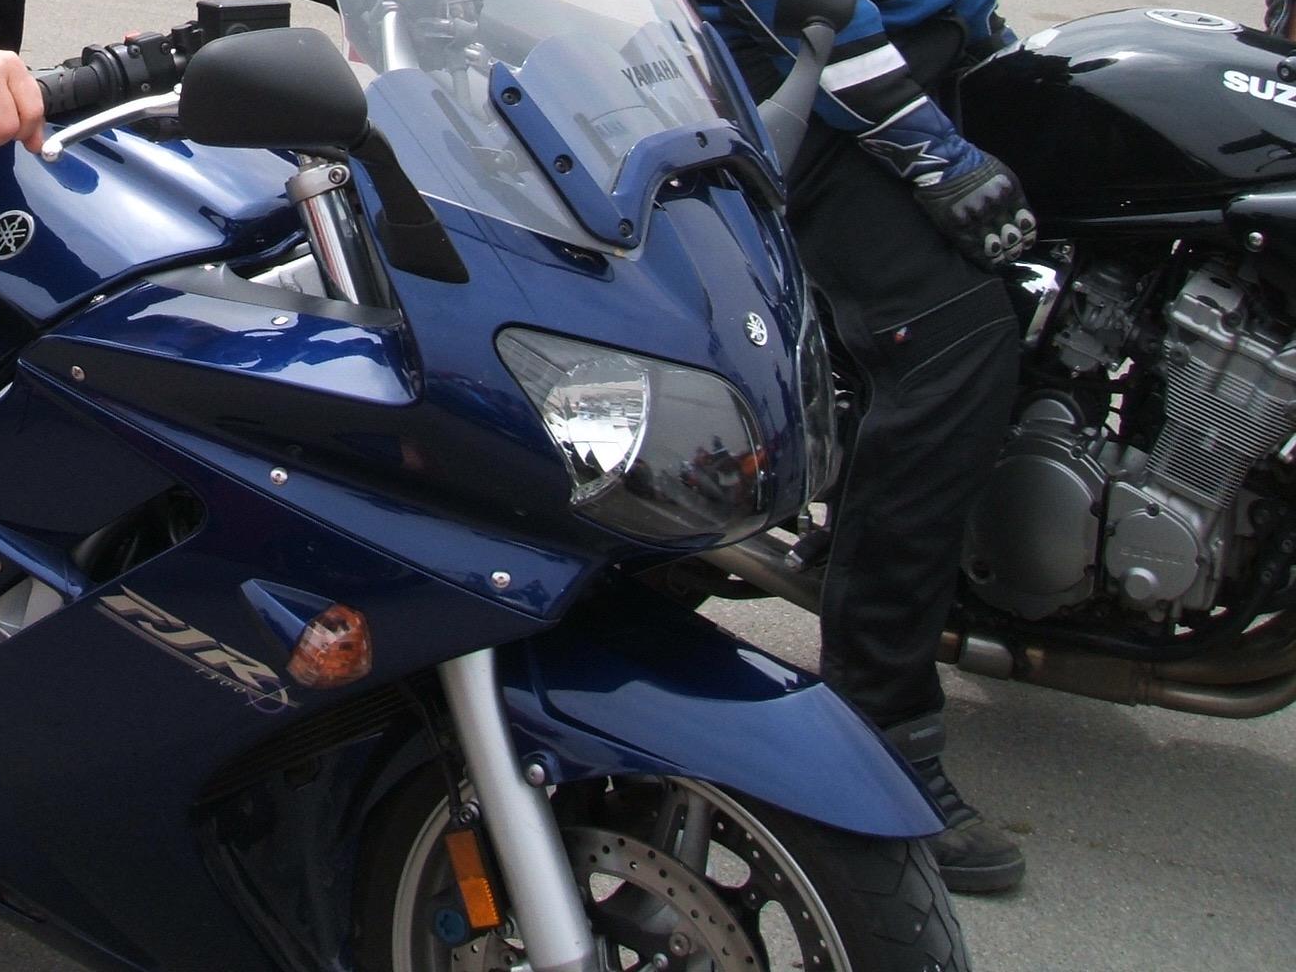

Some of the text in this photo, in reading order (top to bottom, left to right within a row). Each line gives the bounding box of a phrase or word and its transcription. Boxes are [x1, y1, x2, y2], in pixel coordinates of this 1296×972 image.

[620, 59, 683, 89] YAMAHA
[1222, 70, 1296, 108] SUZ
[98, 583, 280, 691] FJR
